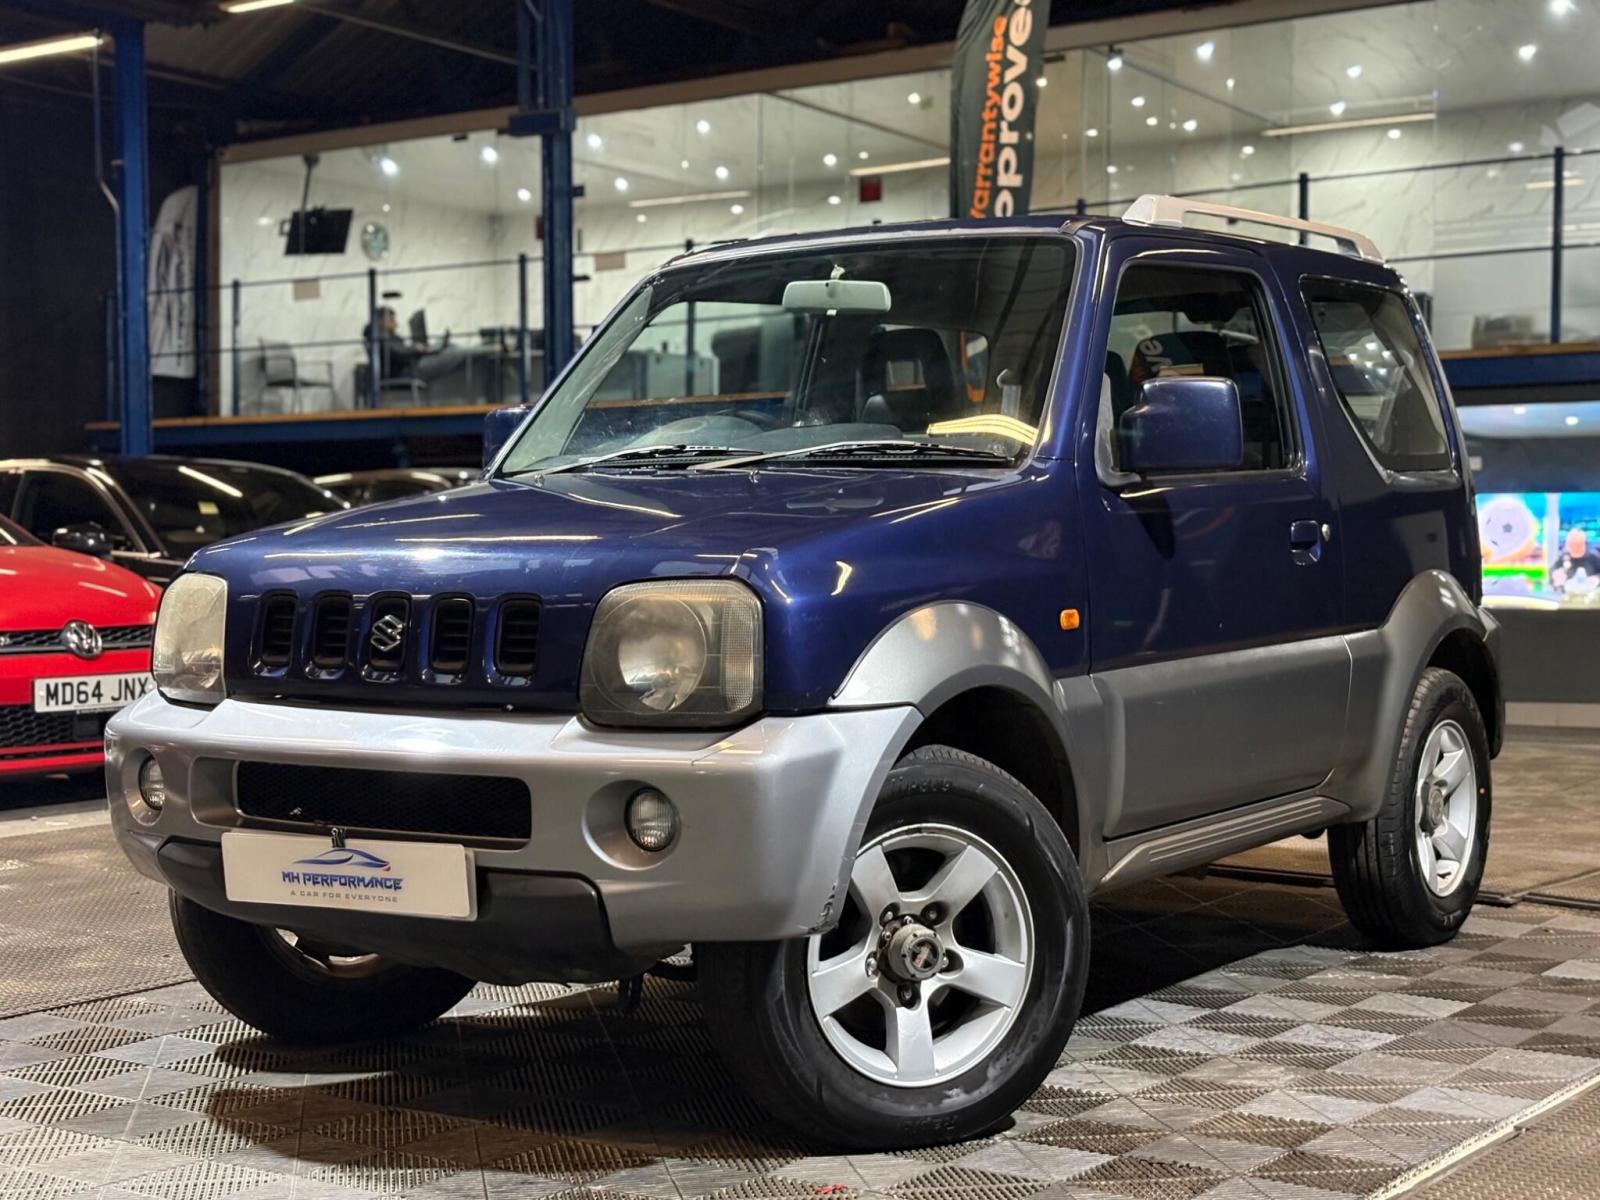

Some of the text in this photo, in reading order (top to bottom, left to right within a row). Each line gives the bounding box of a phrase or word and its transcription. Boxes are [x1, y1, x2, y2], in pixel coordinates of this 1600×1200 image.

[46, 677, 149, 706] MD64 JNX
[281, 871, 403, 891] MH PERFORMANCE
[345, 893, 398, 902] EVERYONE
